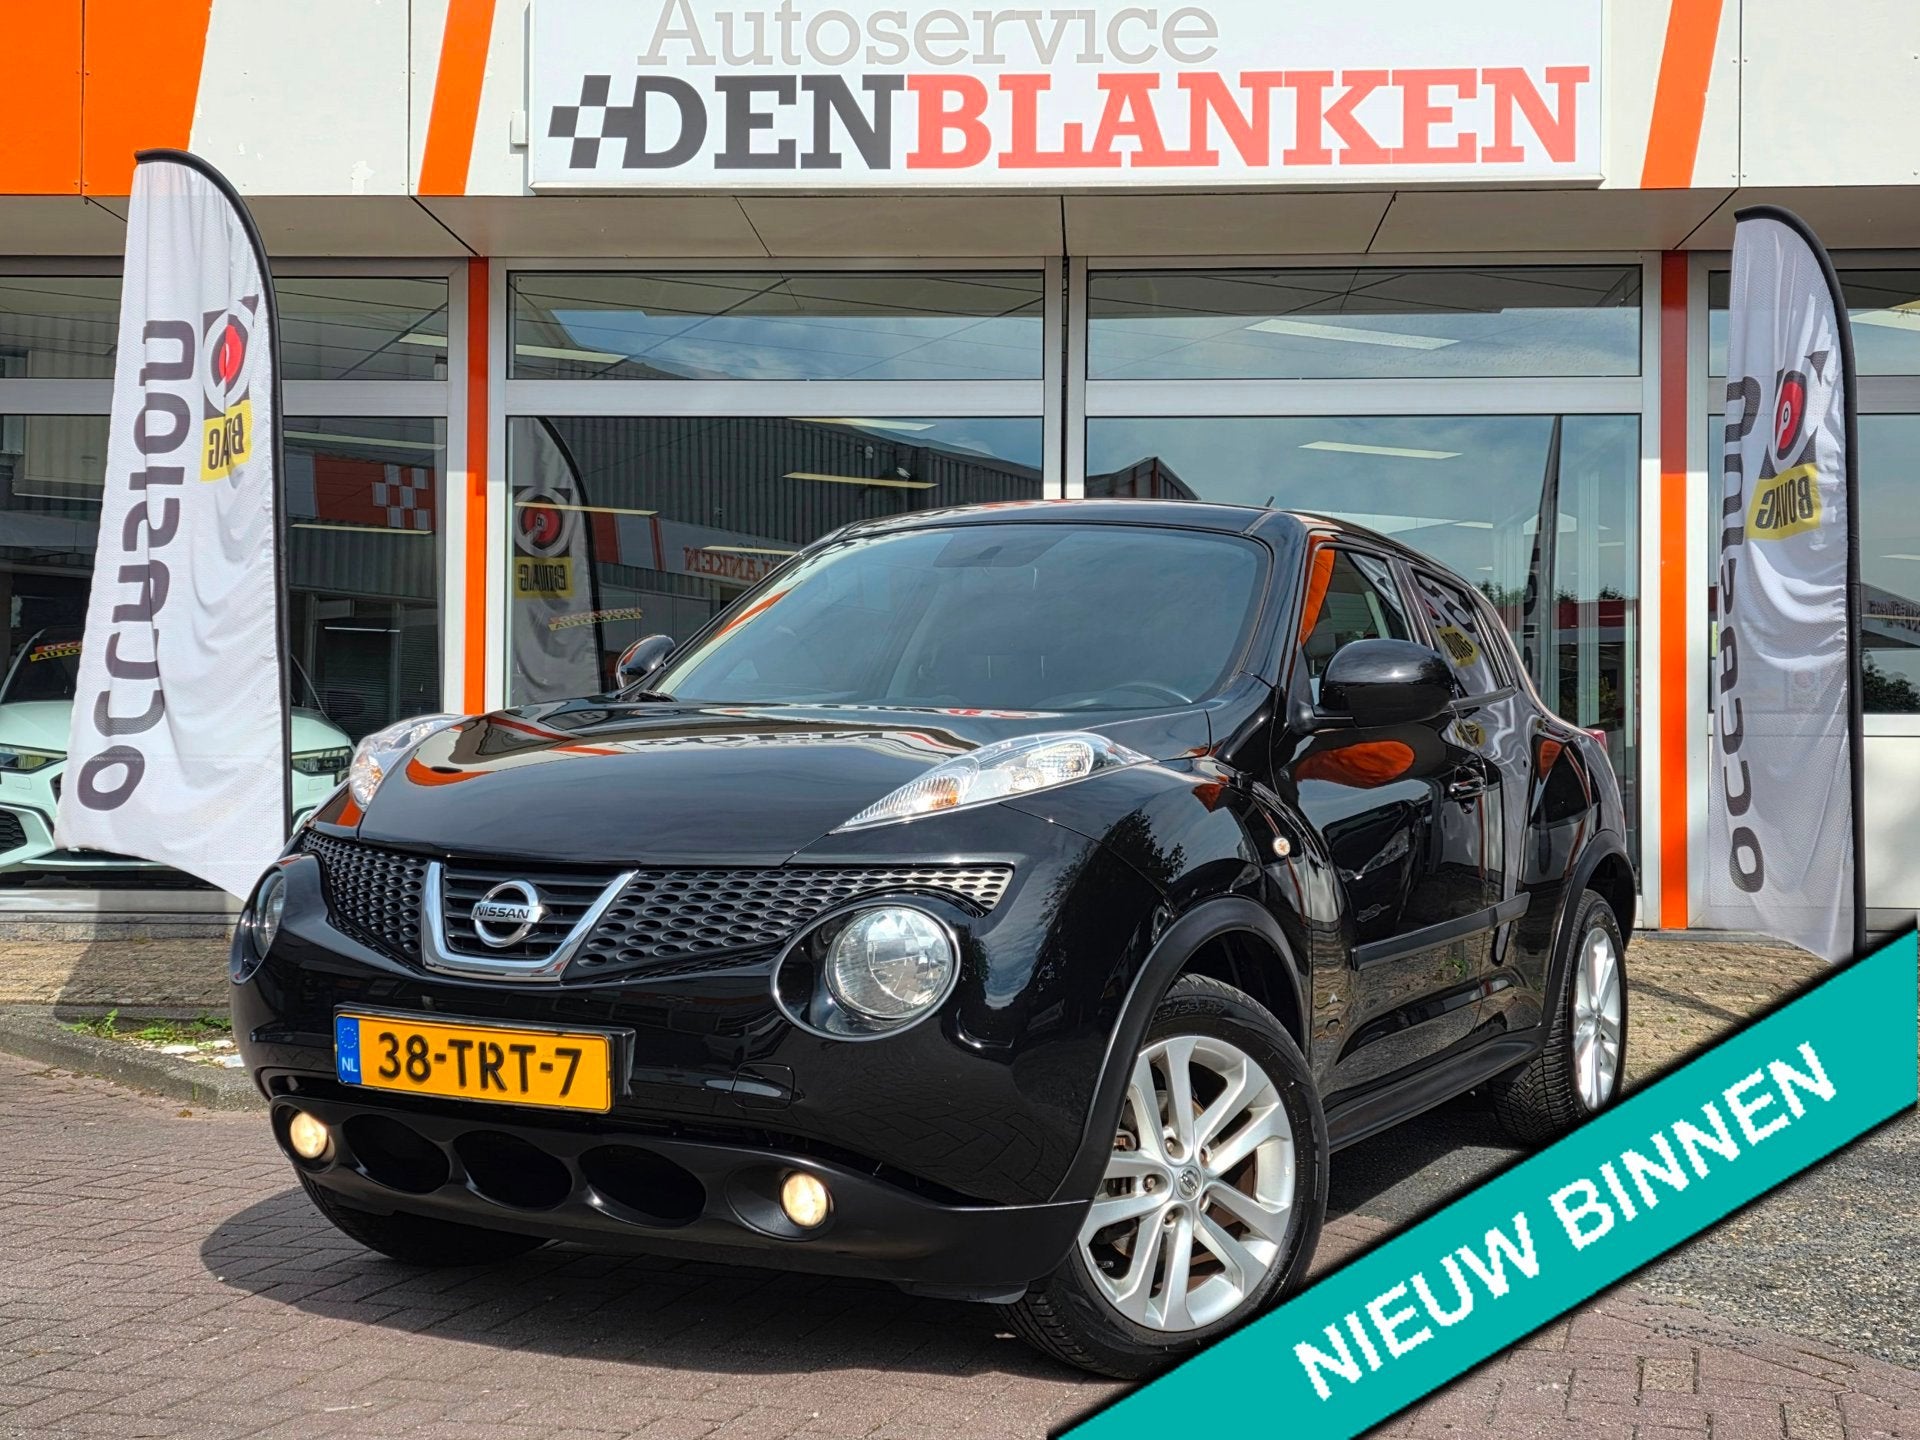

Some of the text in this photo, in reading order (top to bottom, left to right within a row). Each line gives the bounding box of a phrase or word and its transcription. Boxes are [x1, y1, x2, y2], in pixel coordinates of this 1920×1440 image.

[638, 0, 1218, 65] Autoservice
[474, 905, 530, 919] NISSAN
[342, 1057, 358, 1072] NL
[379, 1032, 582, 1097] 38-TRT-7
